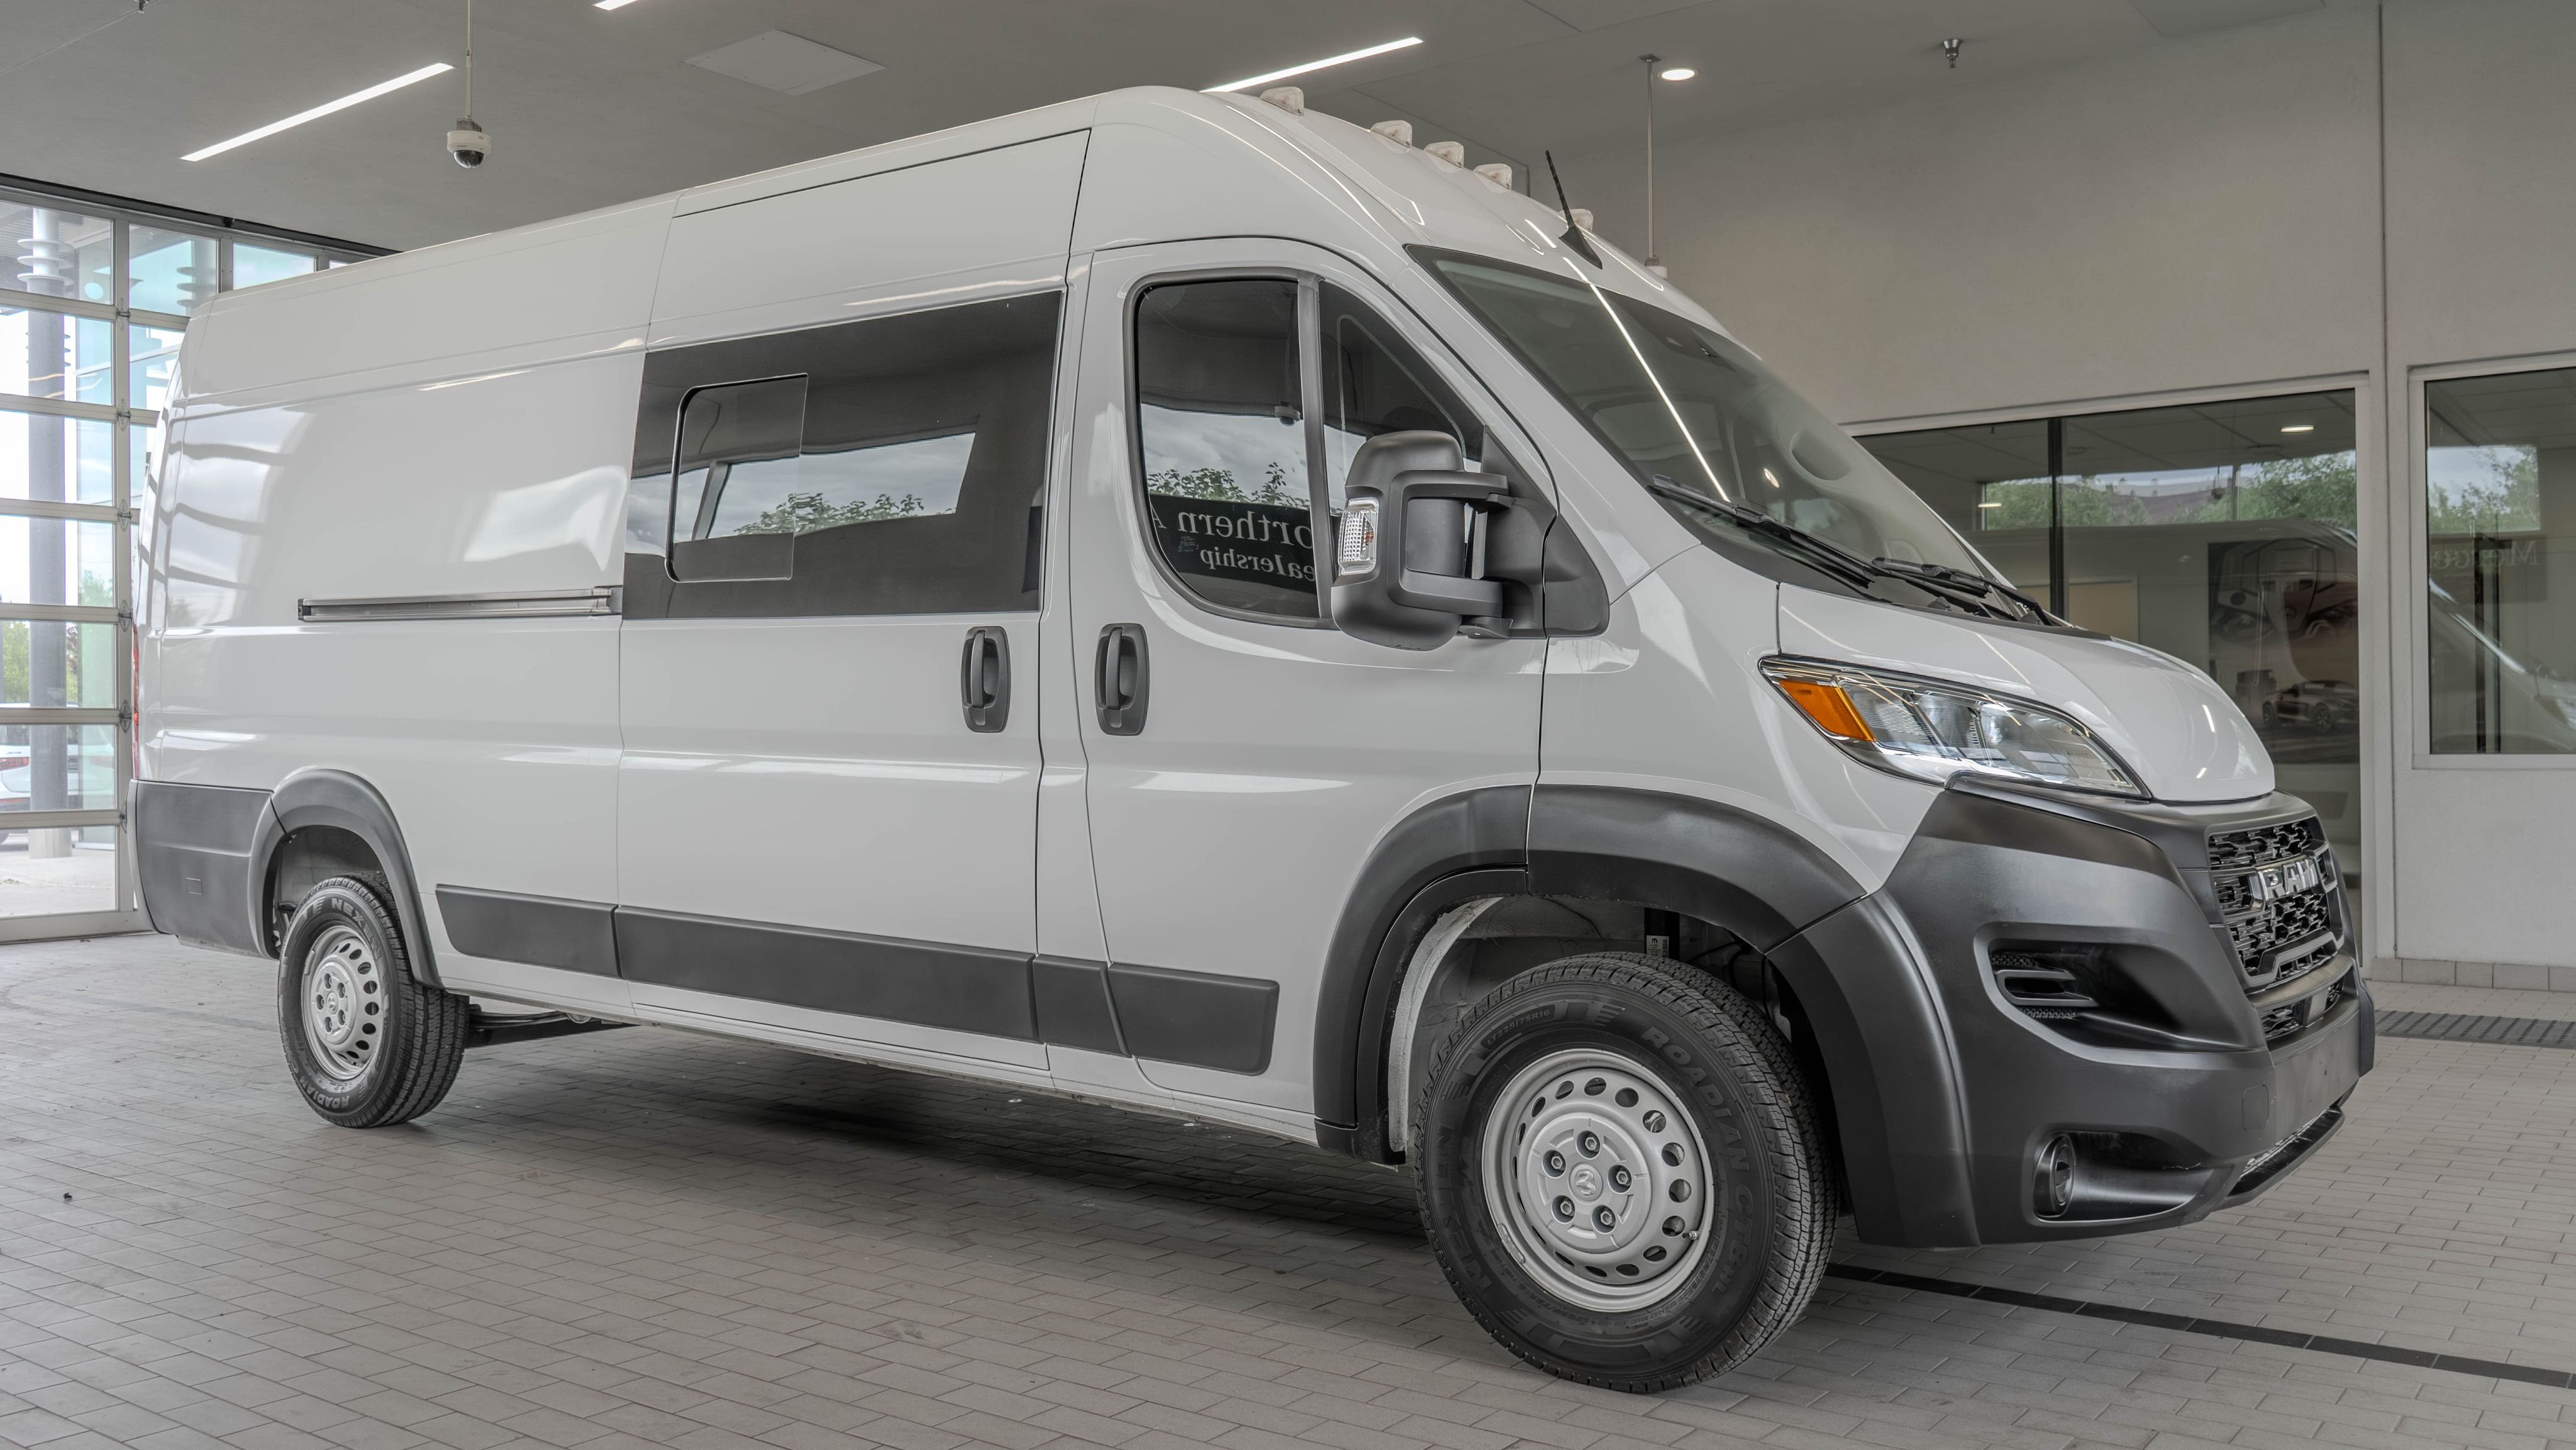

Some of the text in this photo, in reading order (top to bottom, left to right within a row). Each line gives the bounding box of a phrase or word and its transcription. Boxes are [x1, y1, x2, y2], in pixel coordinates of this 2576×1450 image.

[2258, 858, 2319, 901] RAM
[1487, 1009, 1550, 1046] LT225/75R16
[299, 1076, 350, 1108] ROADIAN
[1640, 1026, 1750, 1171] ROADIAN
